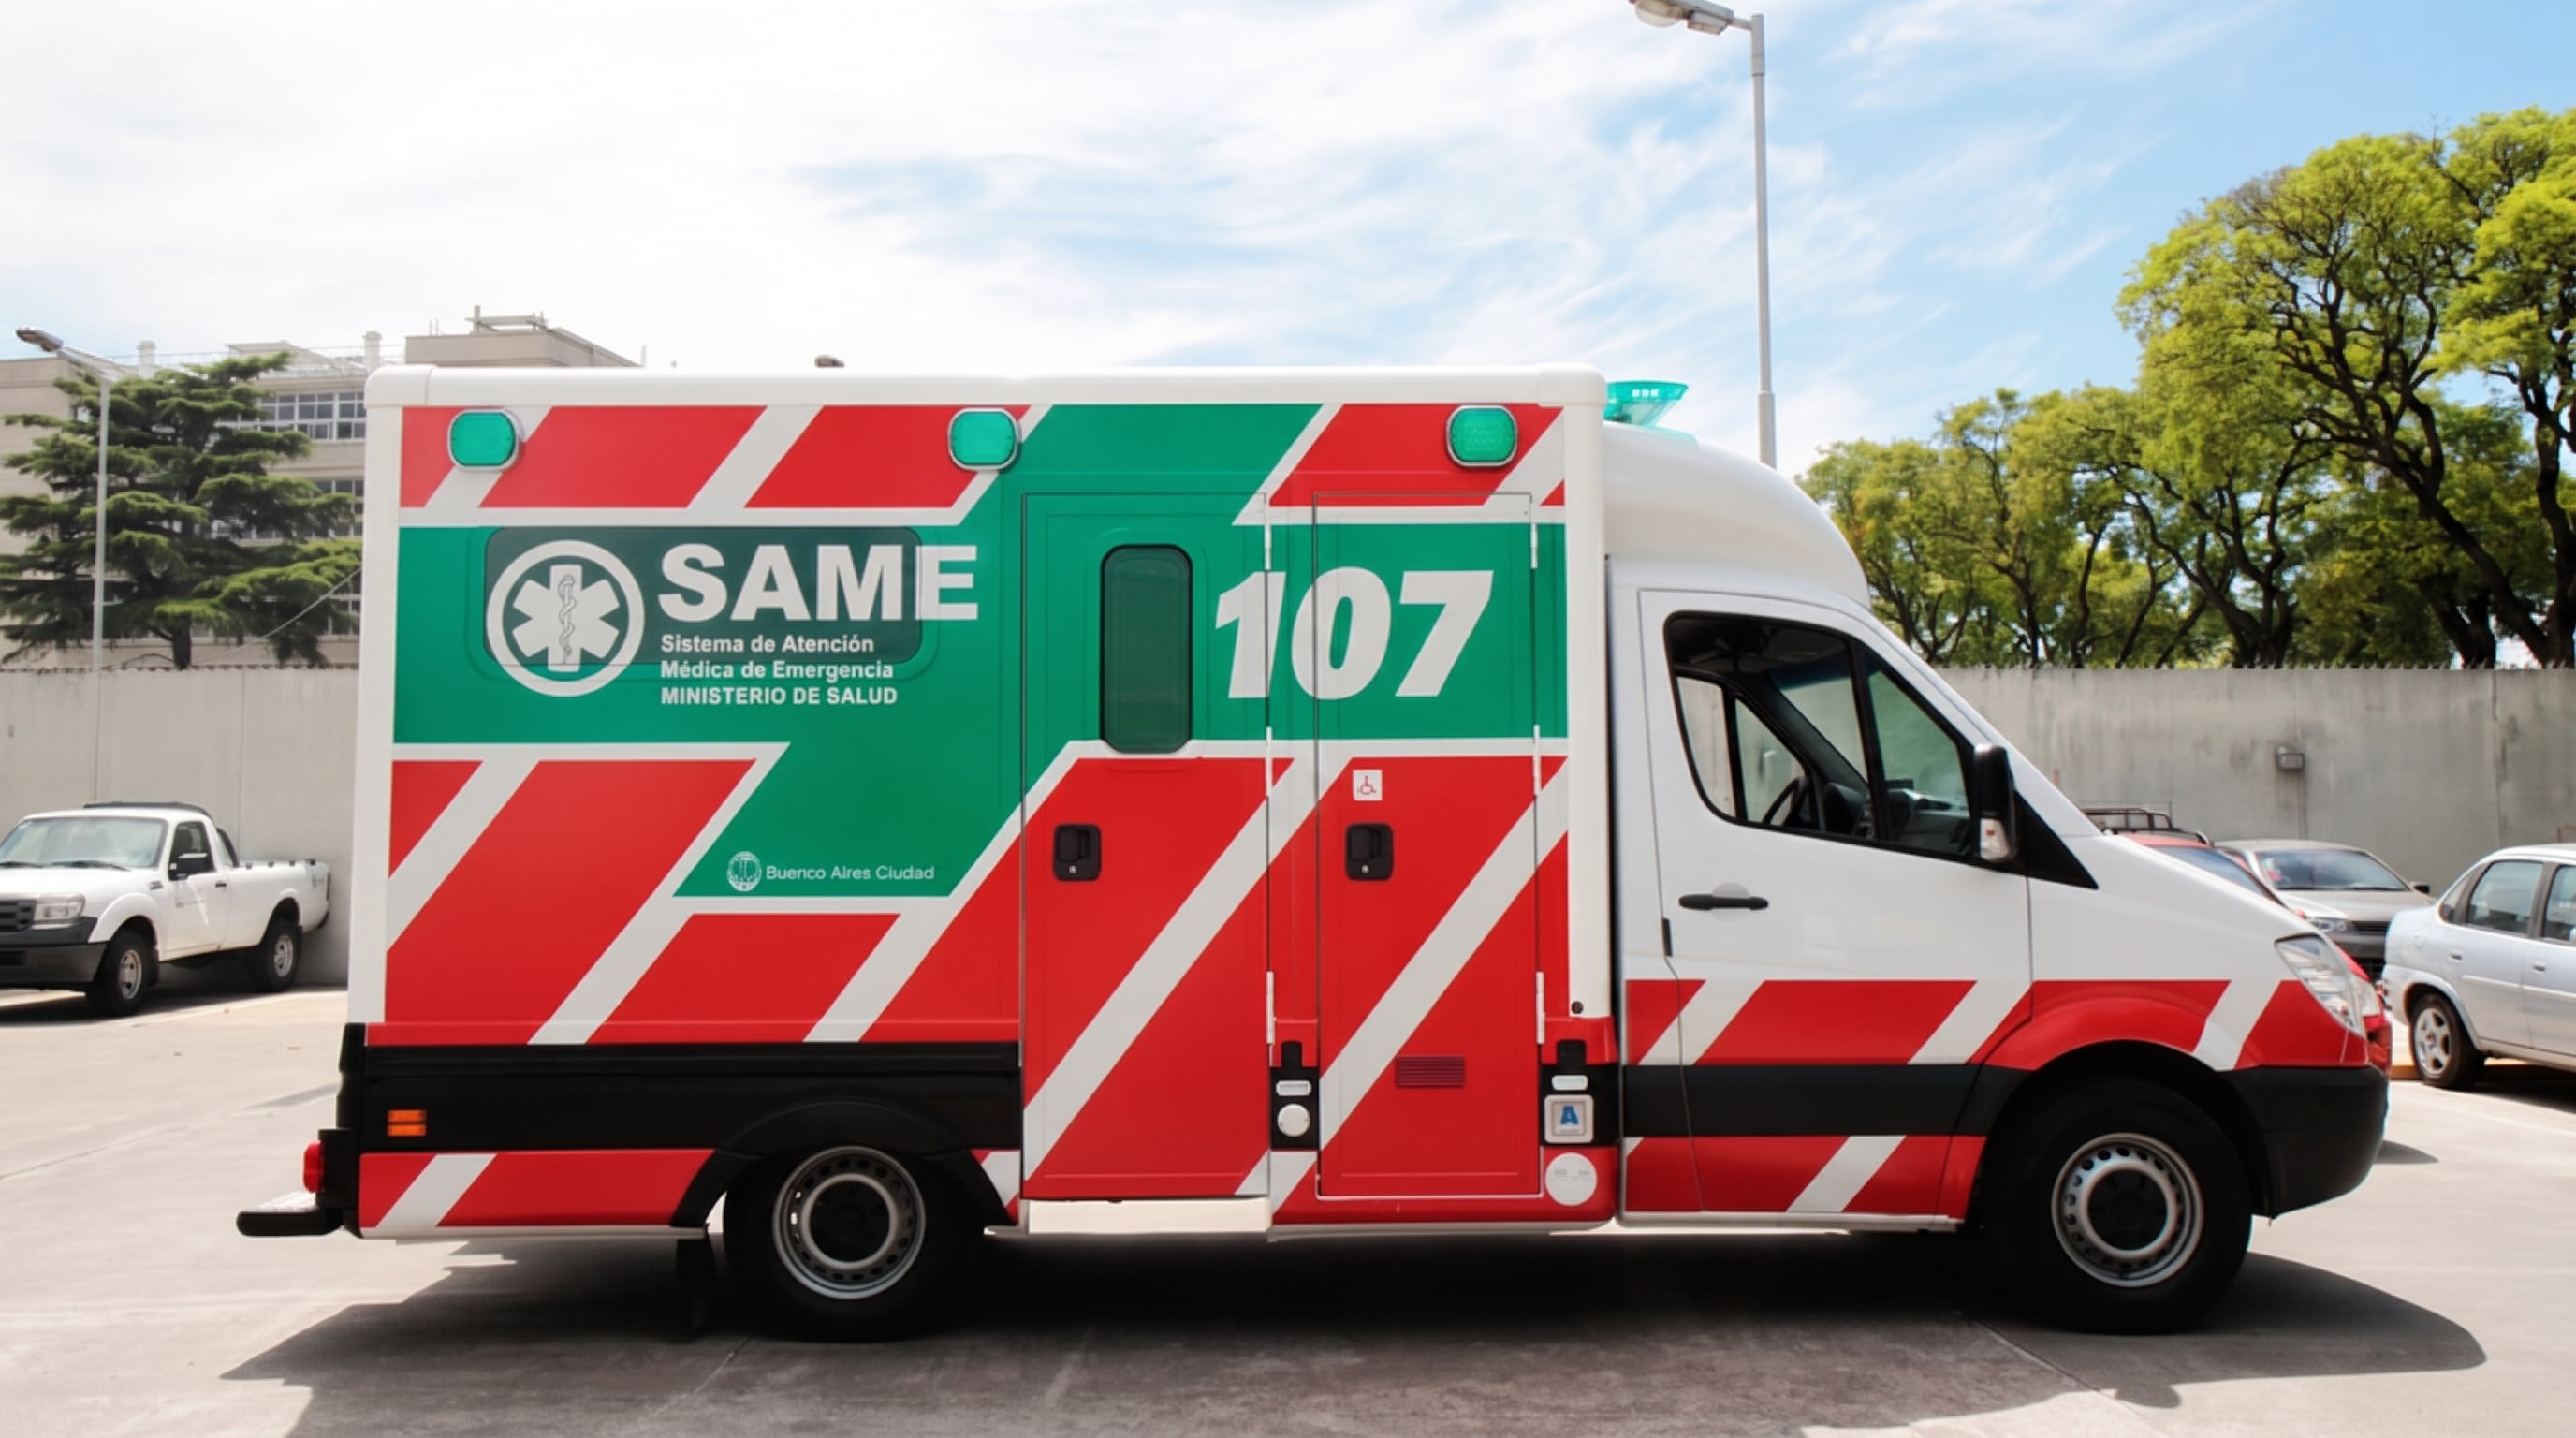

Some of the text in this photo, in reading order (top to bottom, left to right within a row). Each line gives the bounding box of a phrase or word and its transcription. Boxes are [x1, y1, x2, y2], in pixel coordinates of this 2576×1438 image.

[658, 543, 979, 623] SAME
[661, 633, 874, 653] Sistema de Atención
[1215, 565, 1495, 701] 107
[660, 659, 894, 684] Médica de Emergencia
[661, 686, 898, 705] MINISTERIO DE SALUD
[830, 865, 871, 880] Aires
[875, 865, 935, 880] Ciudad
[1560, 1106, 1579, 1125] A
